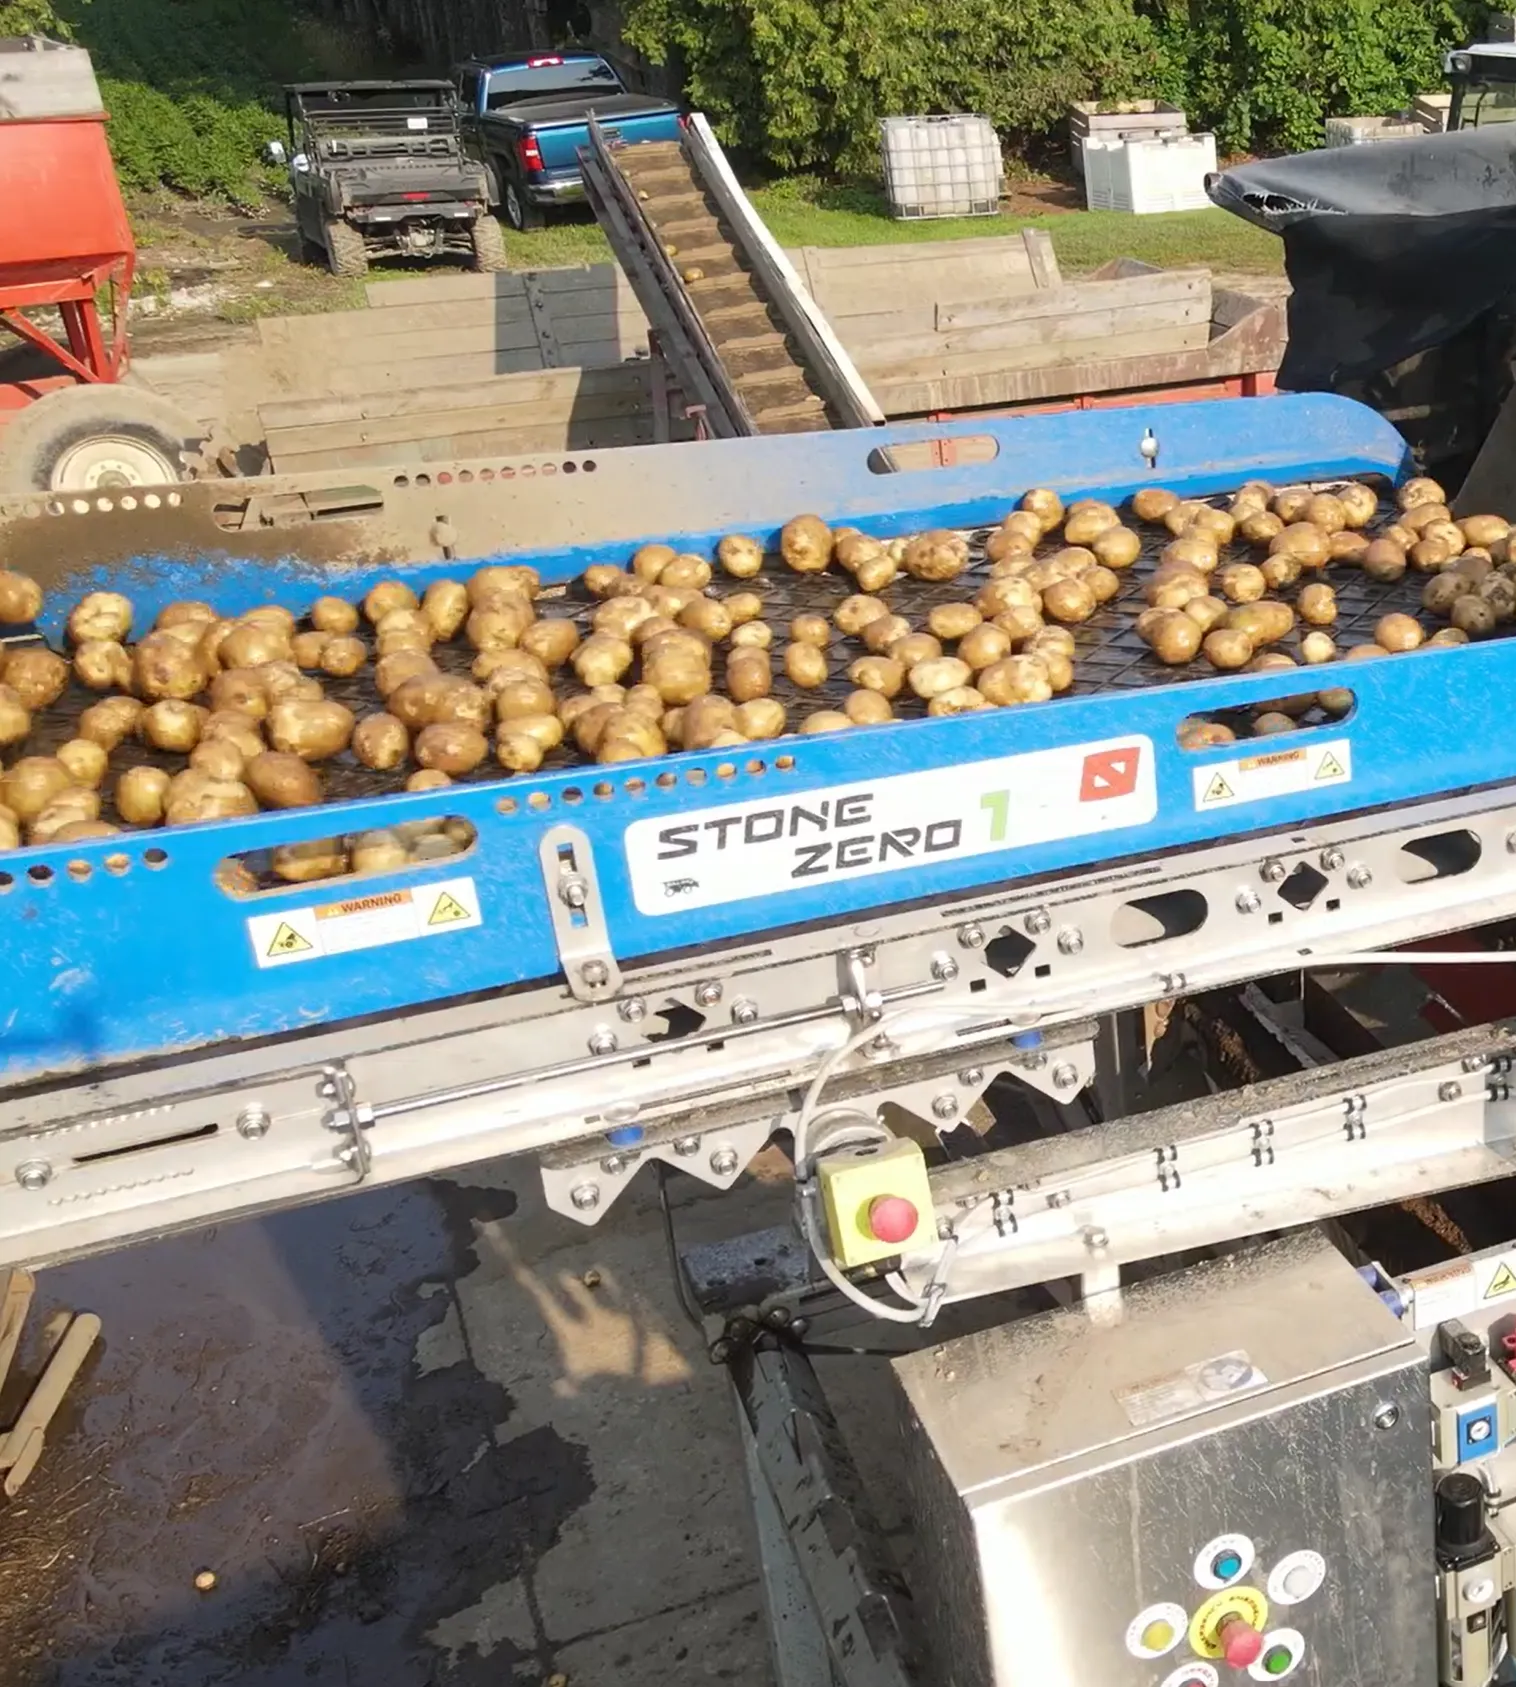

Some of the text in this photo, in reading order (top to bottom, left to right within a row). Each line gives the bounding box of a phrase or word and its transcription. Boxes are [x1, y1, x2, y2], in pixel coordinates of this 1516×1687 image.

[1257, 751, 1299, 765] WARNING
[657, 793, 873, 861] STONE
[791, 789, 1011, 879] ZERO 1
[341, 893, 401, 912] WARNING
